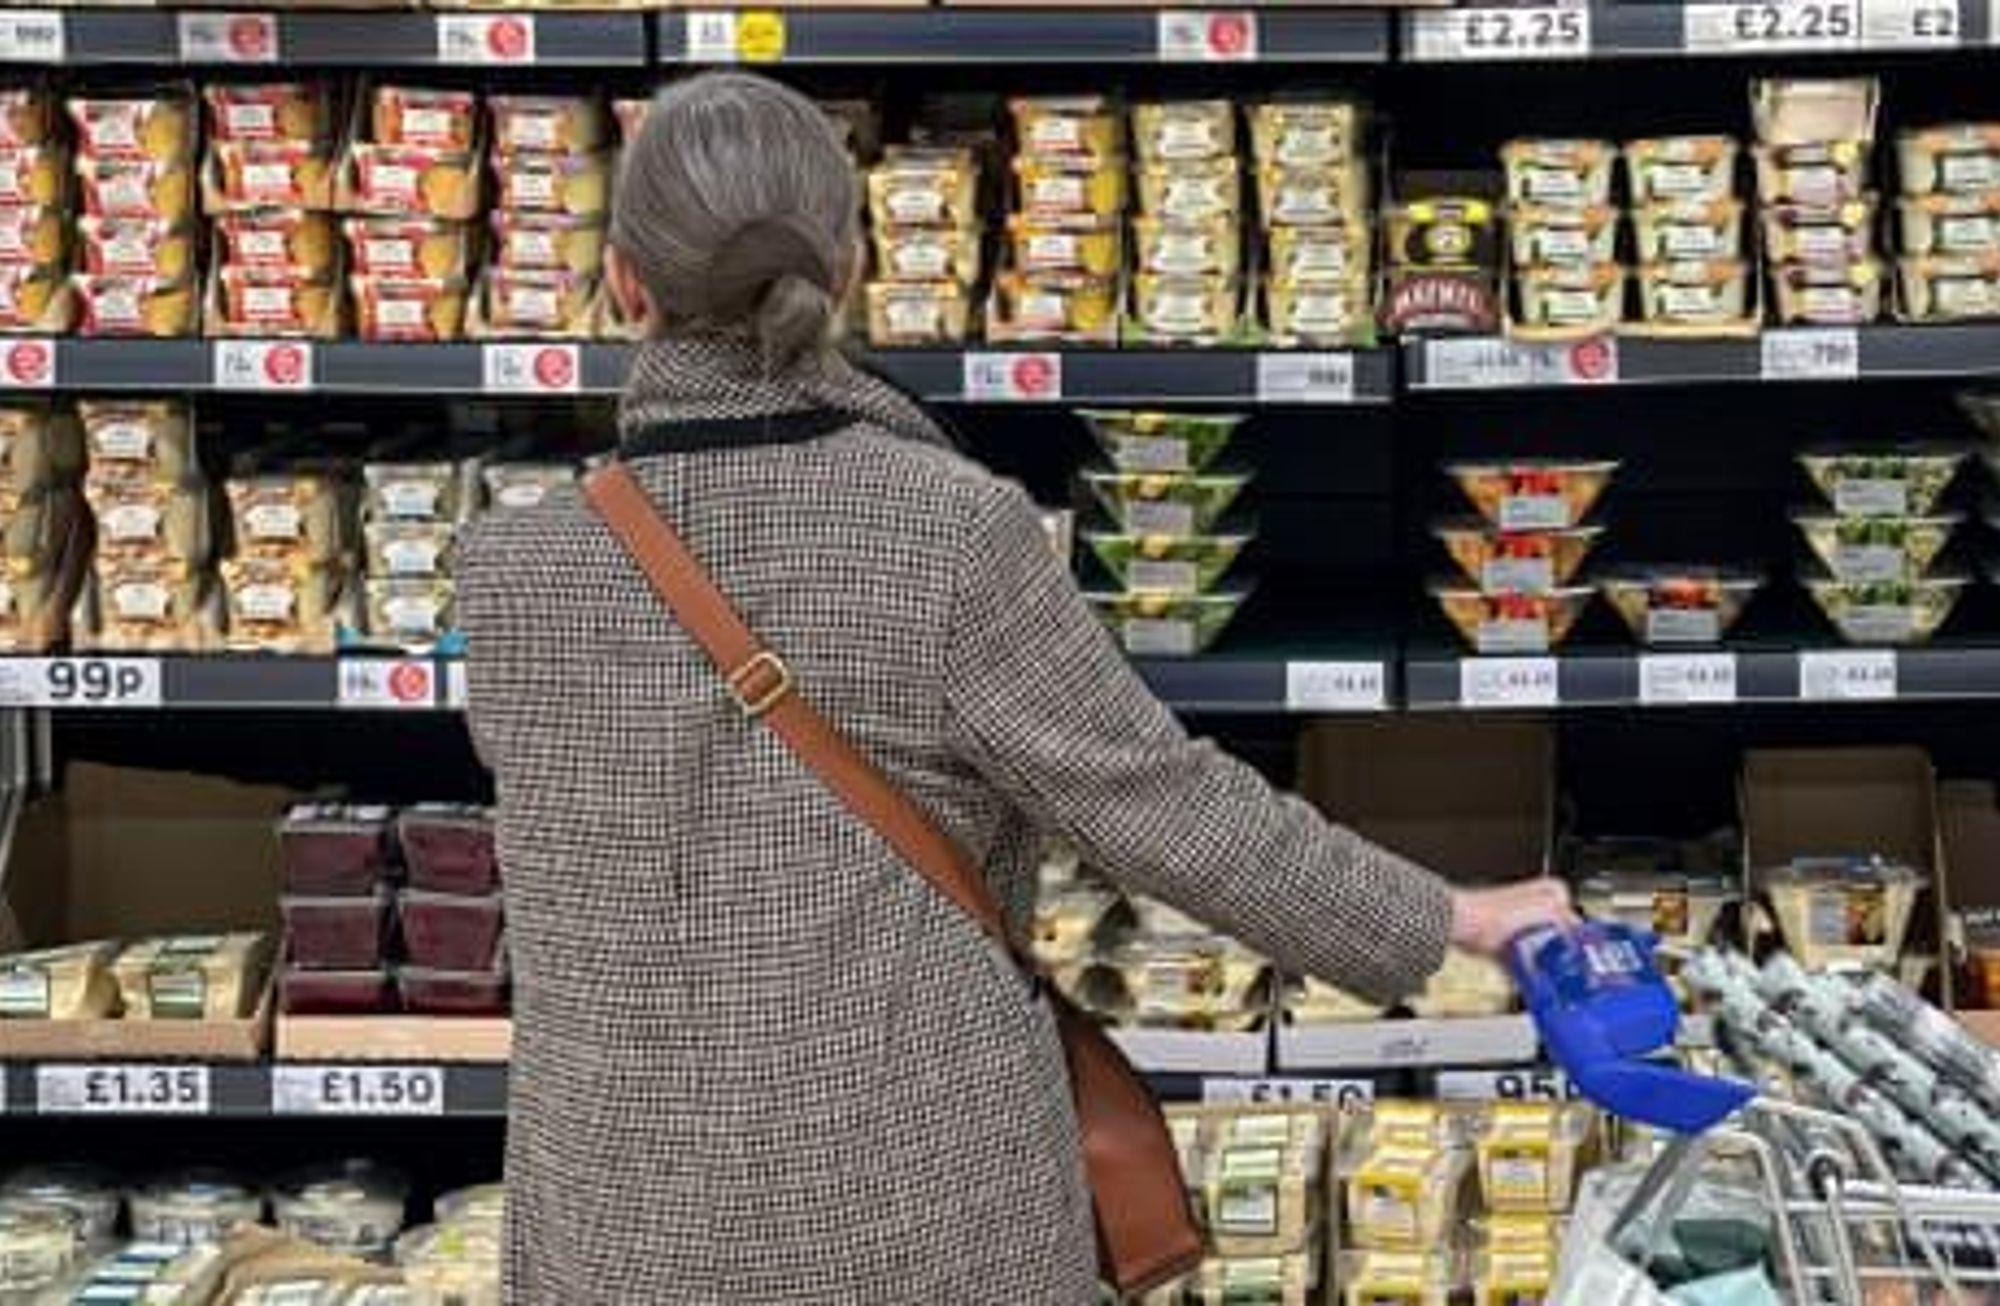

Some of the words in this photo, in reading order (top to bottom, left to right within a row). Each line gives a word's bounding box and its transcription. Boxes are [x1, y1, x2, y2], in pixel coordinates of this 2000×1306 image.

[1464, 13, 1581, 46] £2.25
[1734, 5, 1850, 39] £2.25
[48, 661, 143, 698] 99p
[85, 1070, 199, 1104] £1.35
[322, 1070, 434, 1104] £1.50
[1252, 1084, 1364, 1109] £150
